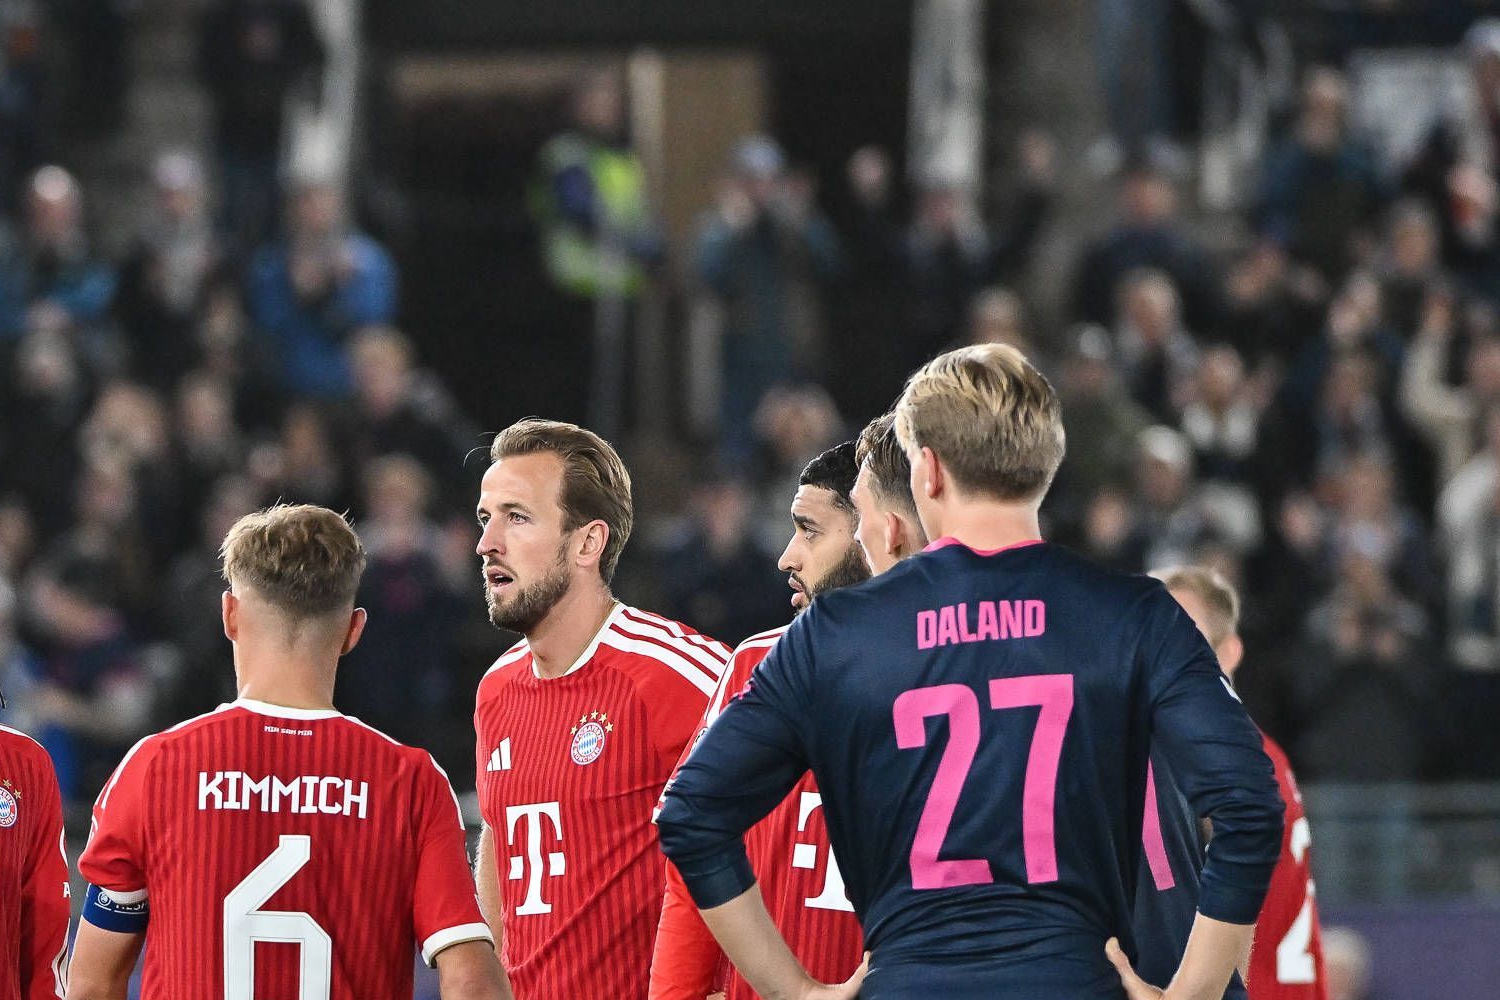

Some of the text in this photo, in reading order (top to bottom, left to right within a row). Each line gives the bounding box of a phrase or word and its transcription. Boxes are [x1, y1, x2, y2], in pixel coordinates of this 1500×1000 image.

[916, 599, 1046, 650] DALAND
[198, 771, 369, 819] KIMMICH
[892, 673, 1075, 890] 27
